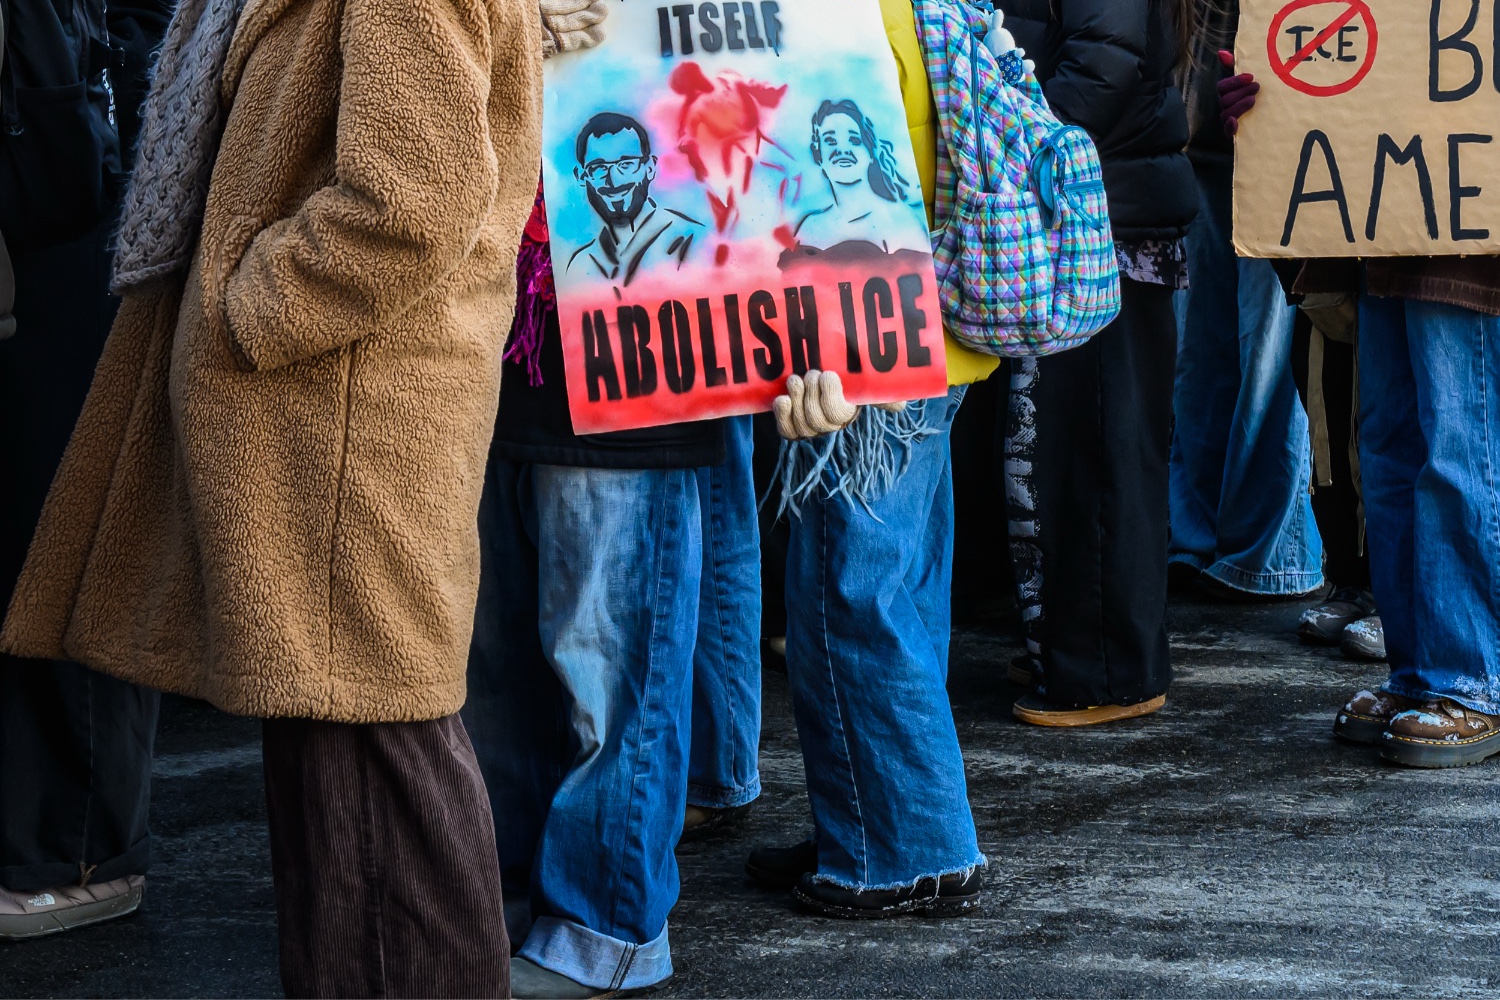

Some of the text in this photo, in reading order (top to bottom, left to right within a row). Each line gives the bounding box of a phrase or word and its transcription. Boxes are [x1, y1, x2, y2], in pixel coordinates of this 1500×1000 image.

[656, 0, 781, 58] ITSELF
[581, 273, 932, 403] ABOLISH ICE
